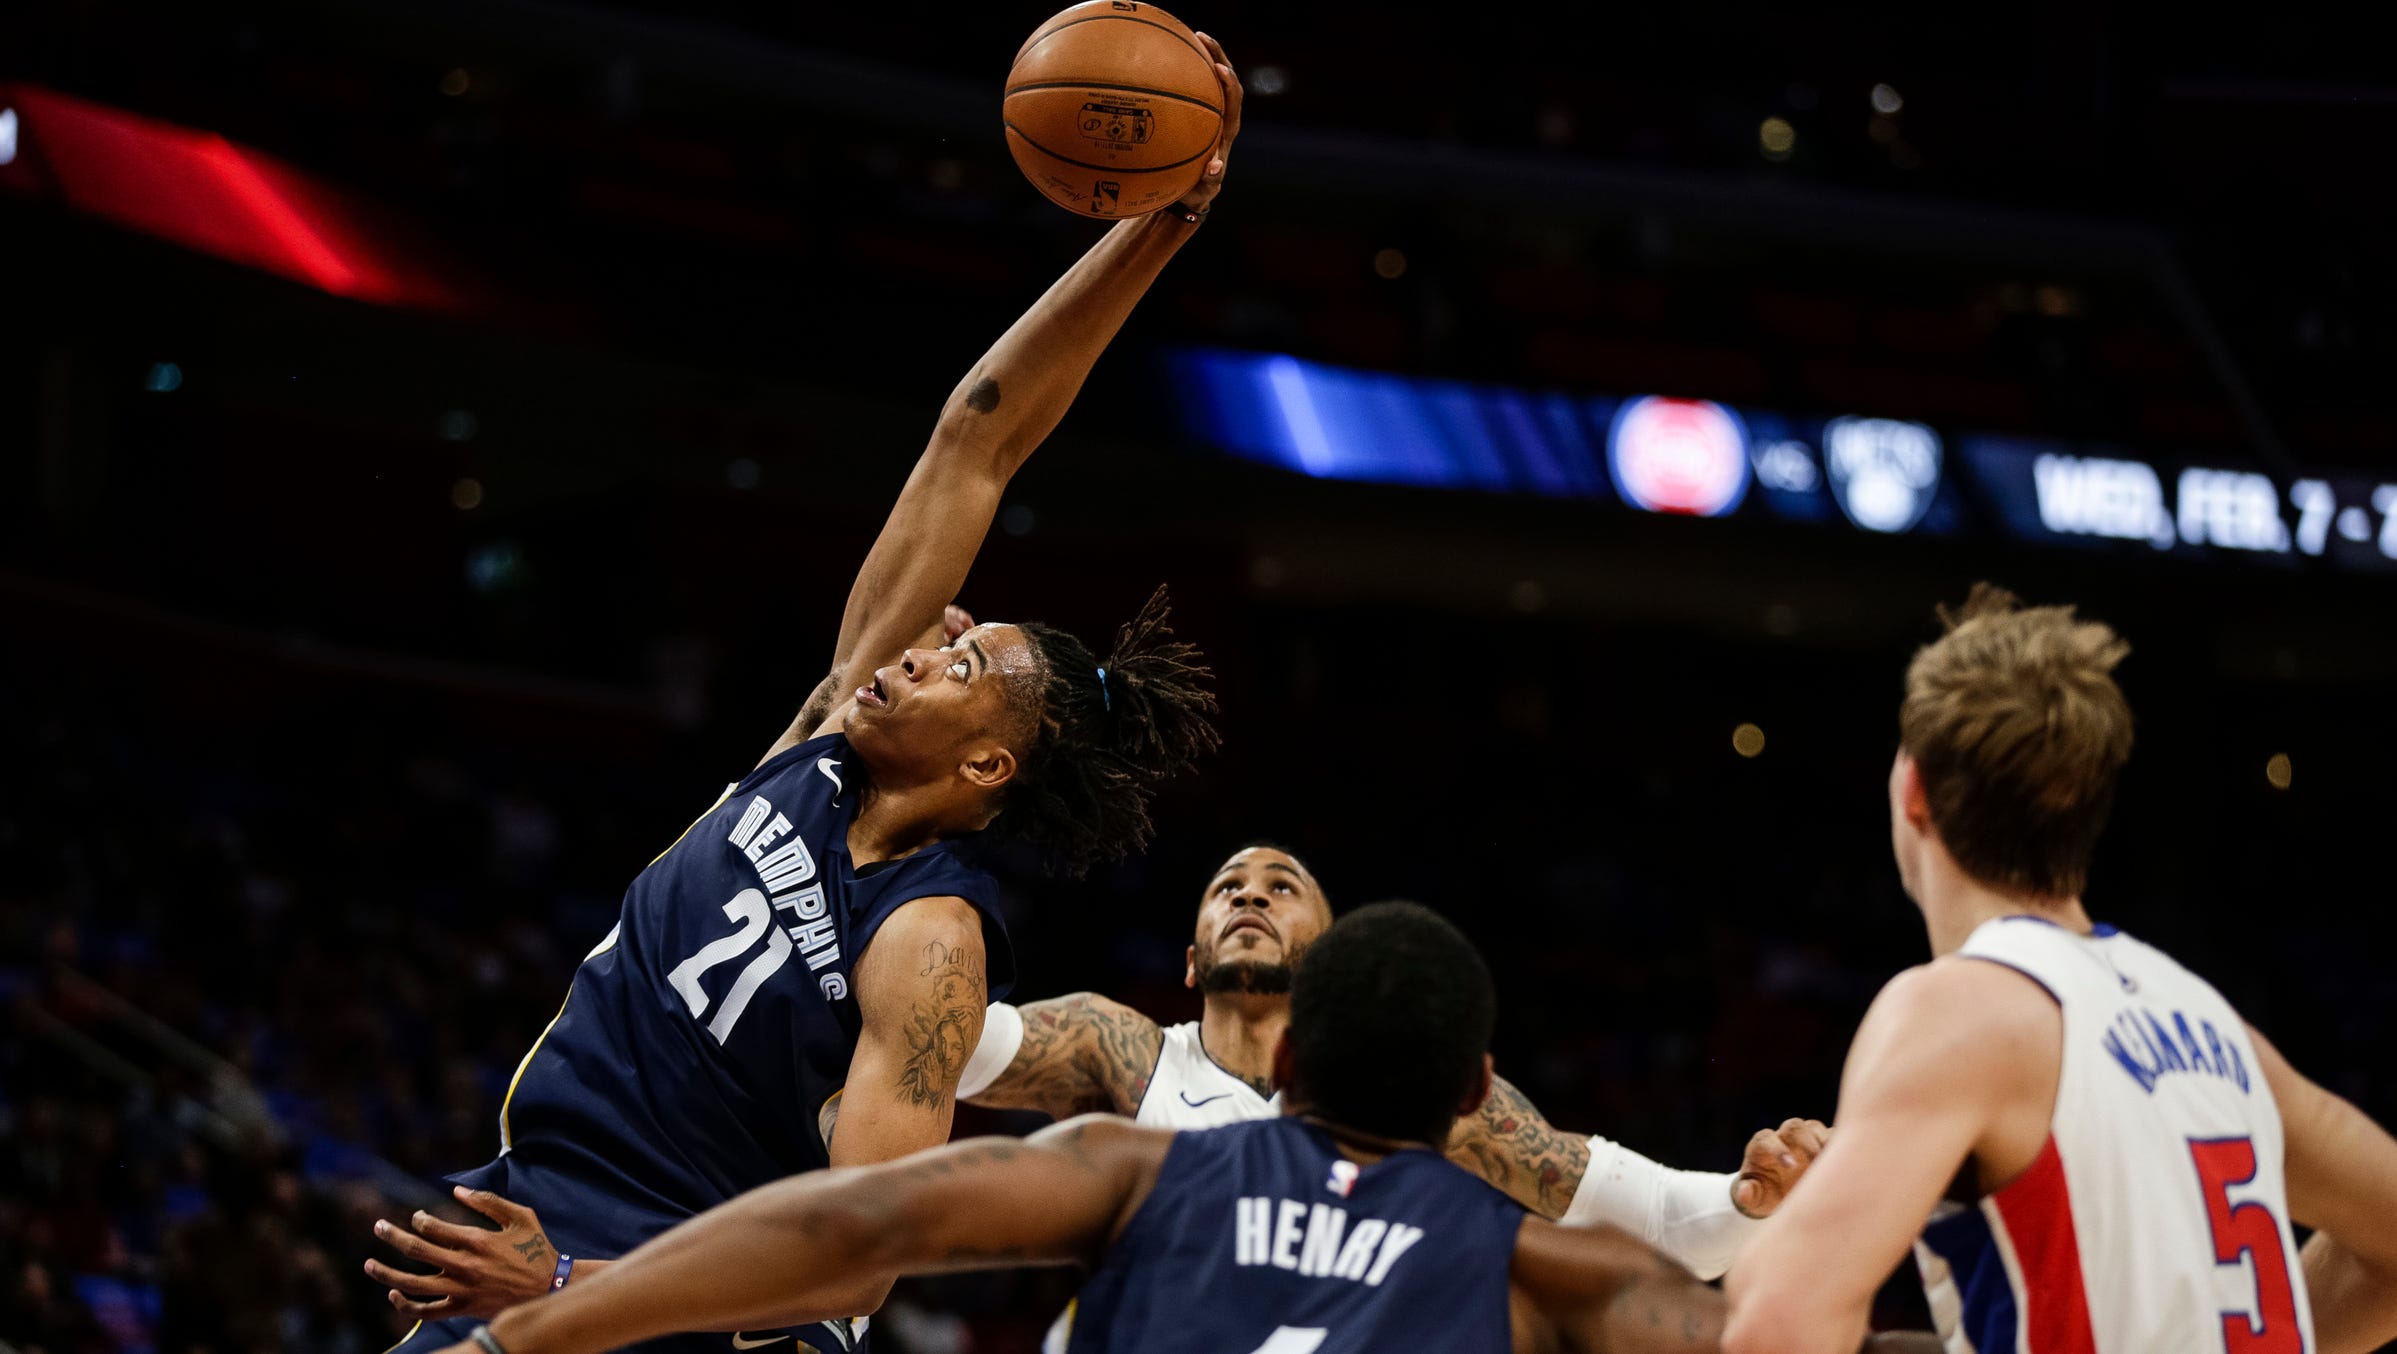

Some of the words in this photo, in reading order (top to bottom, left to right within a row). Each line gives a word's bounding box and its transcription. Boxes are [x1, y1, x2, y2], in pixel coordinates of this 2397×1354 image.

[667, 887, 793, 1047] 21
[1235, 1196, 1425, 1287] HENRY
[2186, 1135, 2305, 1354] 5
